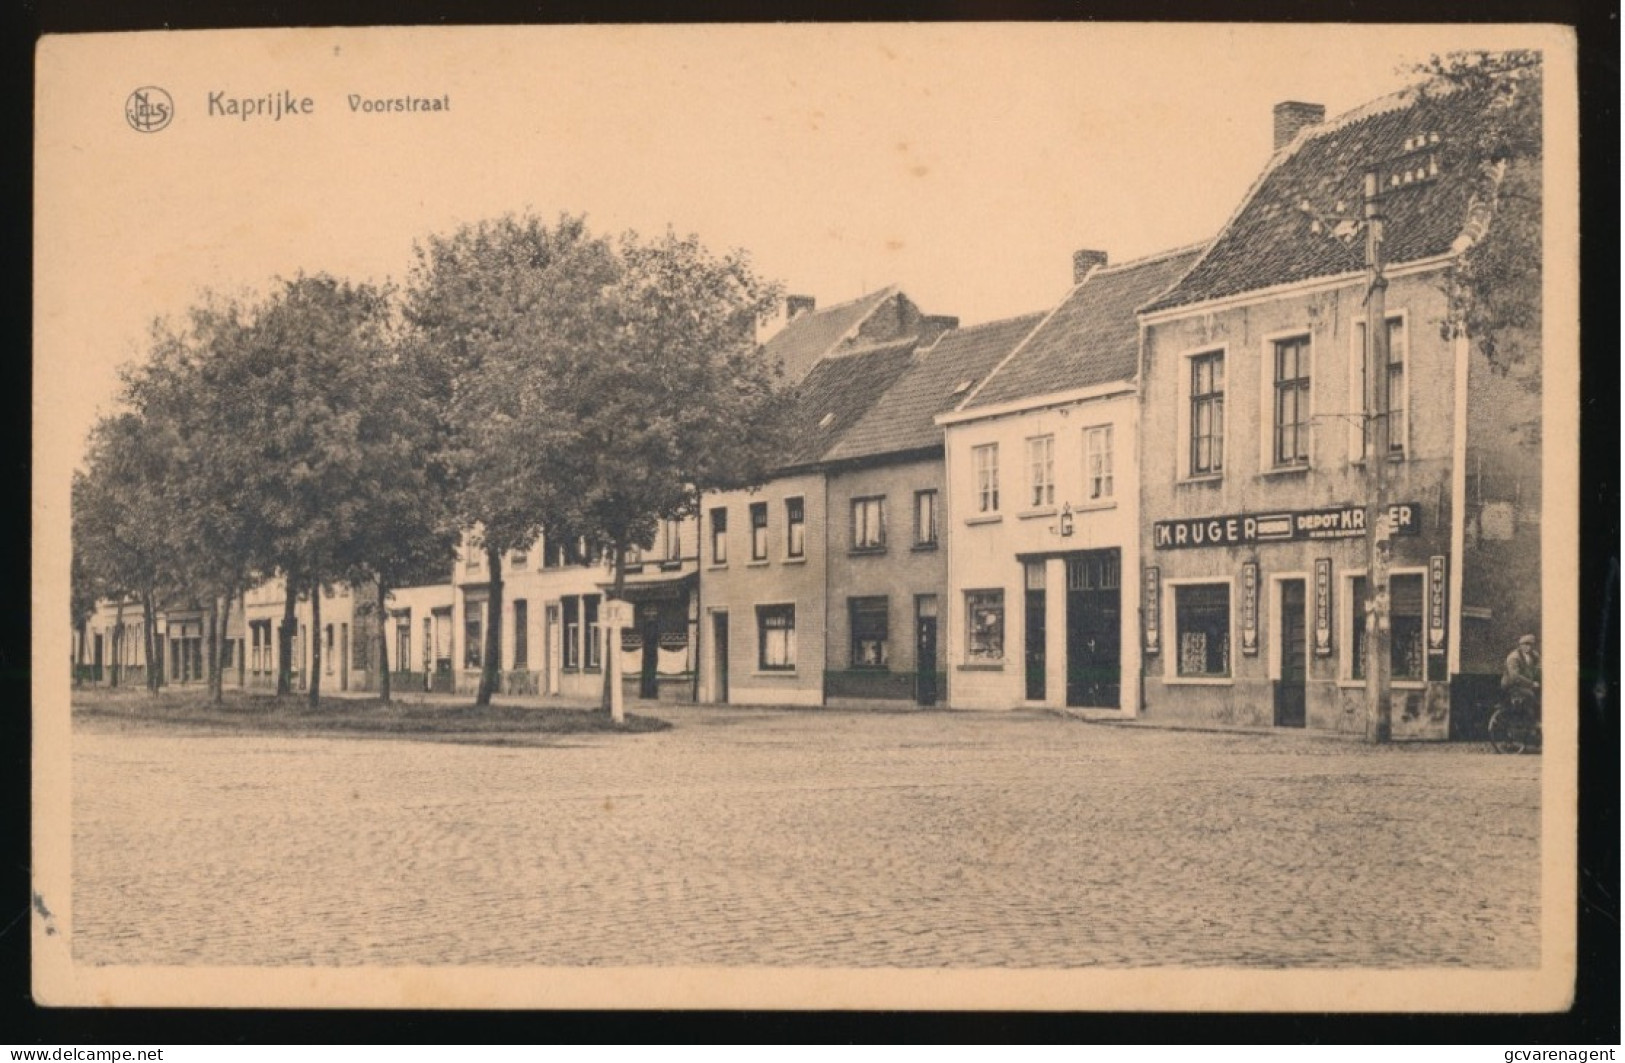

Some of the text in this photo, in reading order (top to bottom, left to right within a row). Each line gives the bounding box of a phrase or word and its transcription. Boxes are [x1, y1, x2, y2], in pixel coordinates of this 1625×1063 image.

[207, 90, 451, 121] Kaprijke Voorstraat
[1160, 518, 1257, 544] KRUGER
[1297, 513, 1339, 530] DEPOT
[1340, 506, 1412, 529] KRER
[1432, 558, 1441, 628] KRUGER
